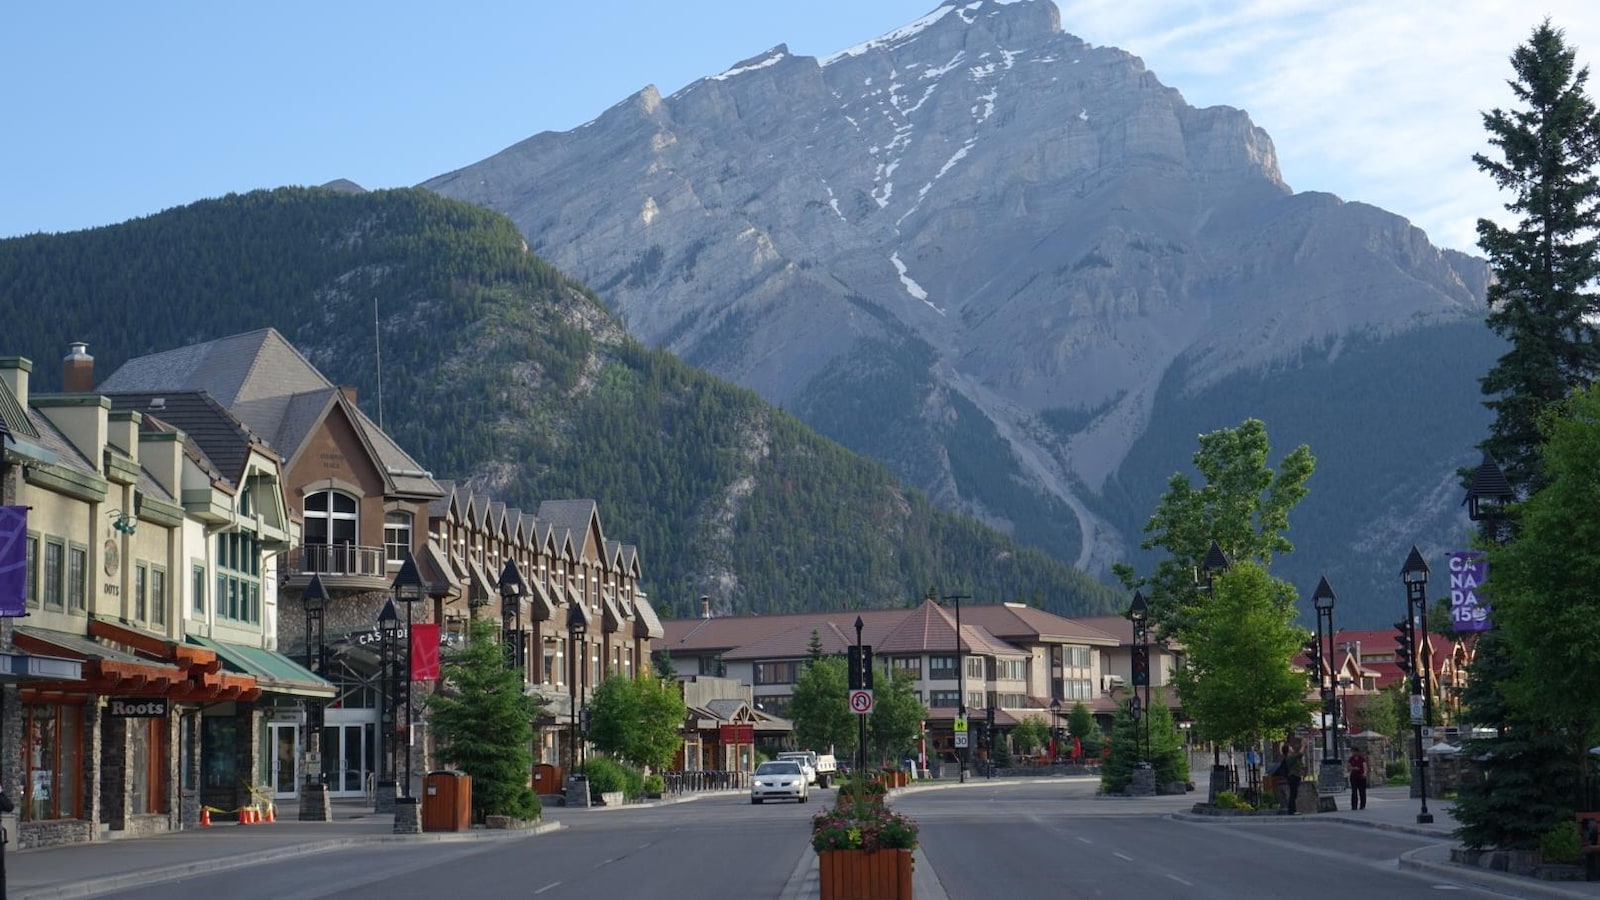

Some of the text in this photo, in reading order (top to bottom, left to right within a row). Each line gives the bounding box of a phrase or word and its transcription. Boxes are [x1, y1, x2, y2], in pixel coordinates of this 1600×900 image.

[1449, 556, 1476, 571] CA
[1450, 573, 1477, 588] NA
[1451, 590, 1478, 605] DA
[359, 628, 408, 645] CASDE
[112, 701, 164, 715] Roots
[956, 737, 967, 745] 30
